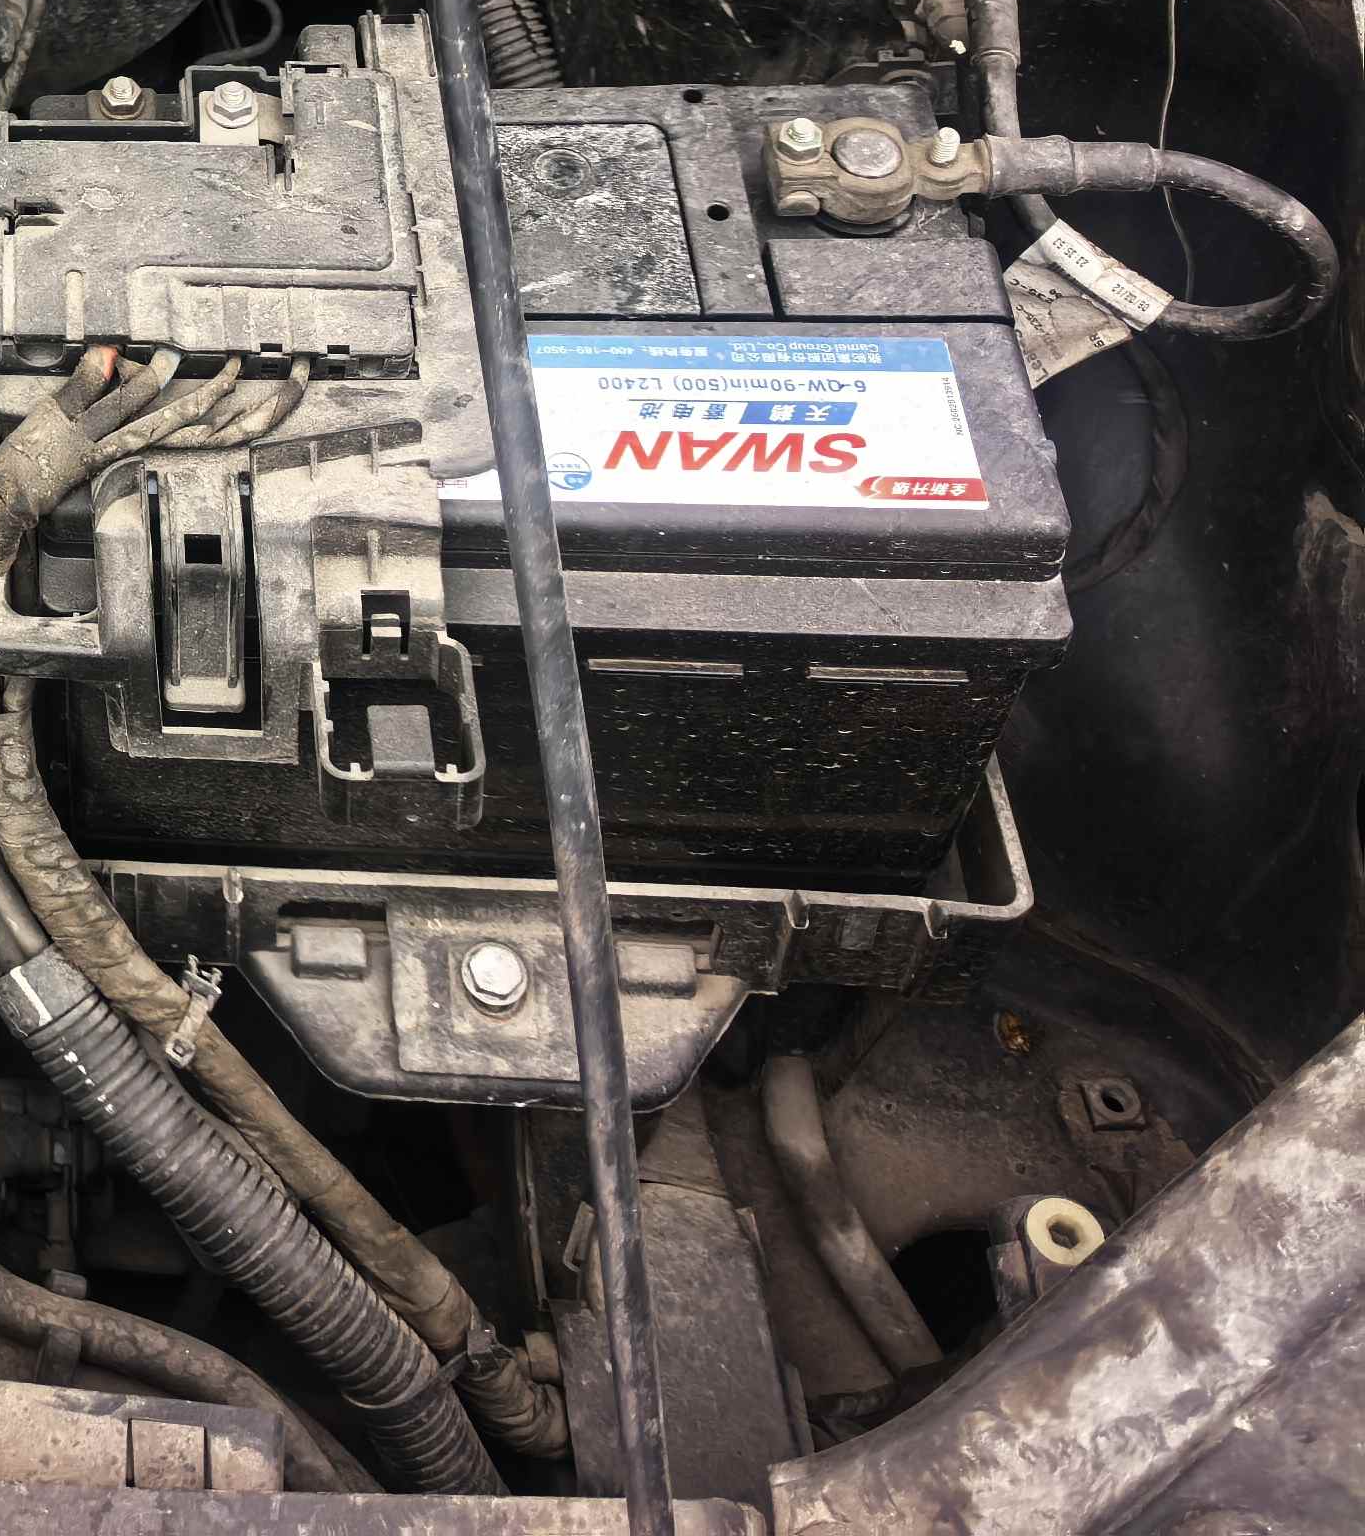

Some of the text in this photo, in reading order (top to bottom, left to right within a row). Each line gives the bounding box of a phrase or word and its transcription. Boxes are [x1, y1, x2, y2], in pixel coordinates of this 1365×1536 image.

[597, 376, 662, 391] L2400
[639, 402, 833, 422] 天鹅 蓄电池
[603, 430, 867, 474] SWAN
[891, 481, 970, 497] 全新升级
